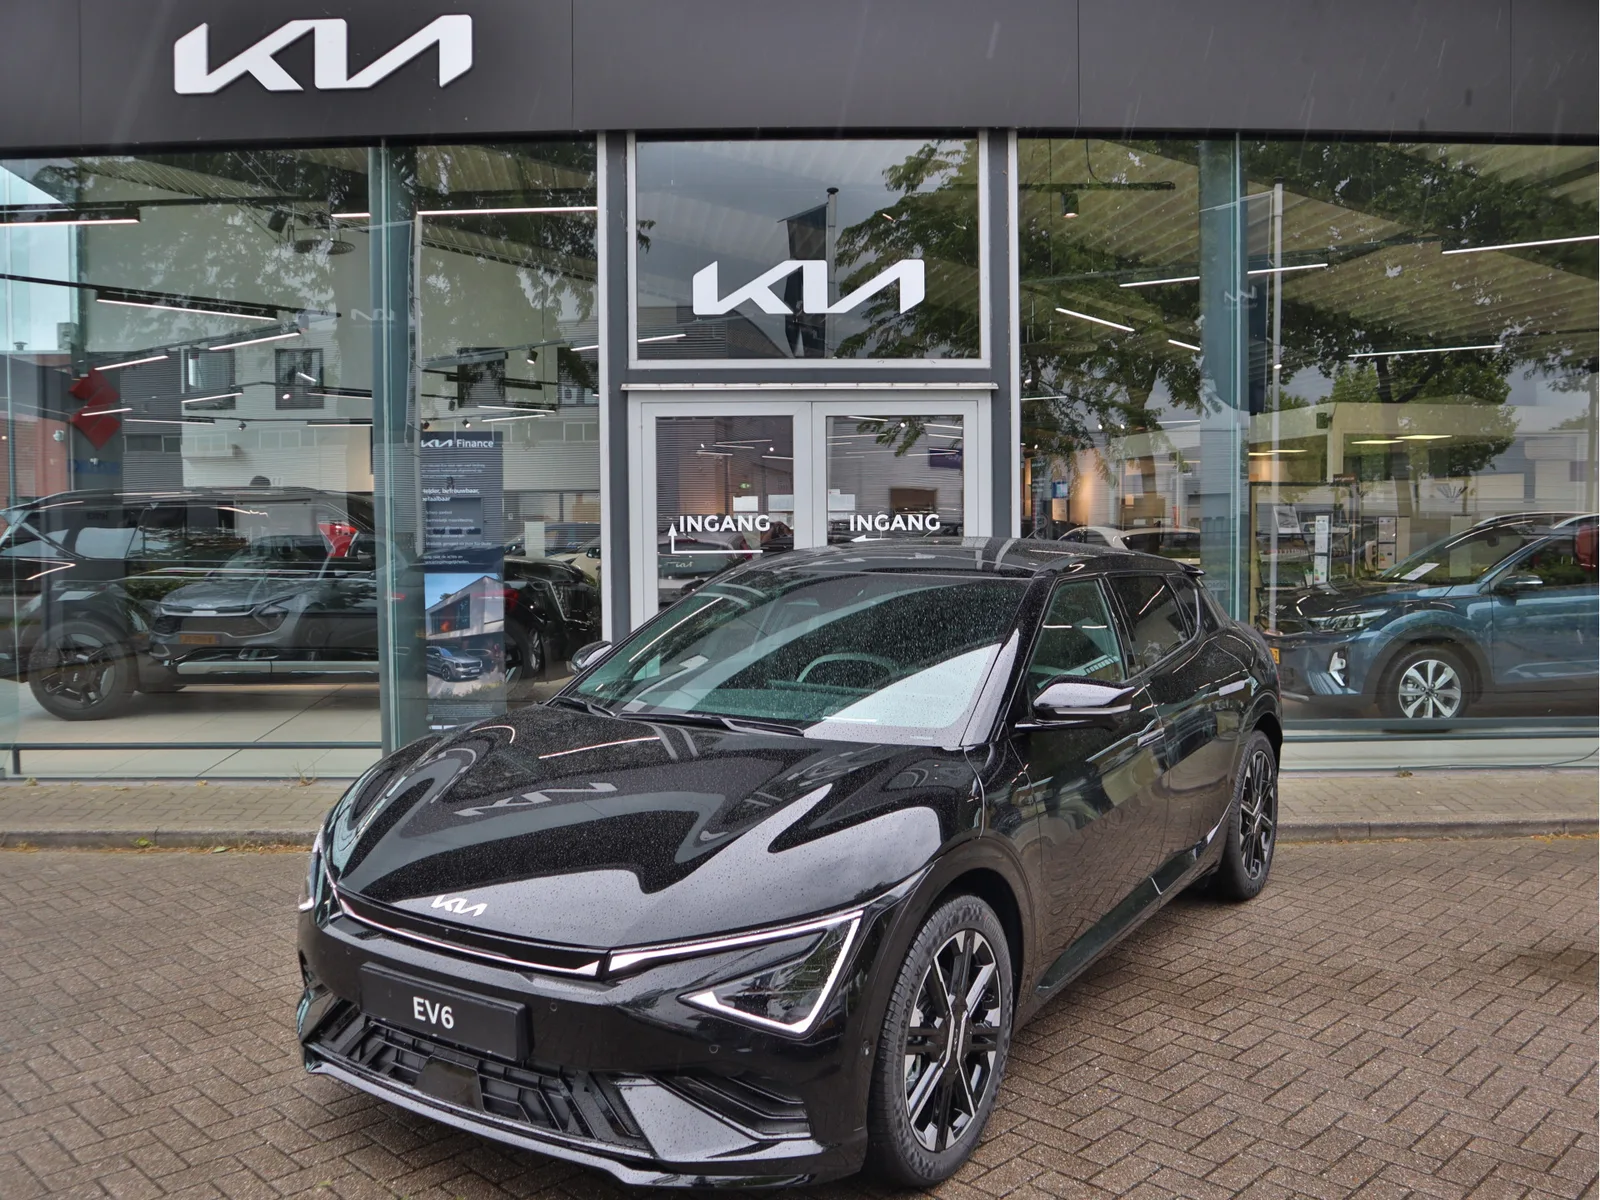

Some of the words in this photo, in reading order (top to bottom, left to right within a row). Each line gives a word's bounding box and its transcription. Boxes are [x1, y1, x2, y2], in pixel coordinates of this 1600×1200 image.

[174, 14, 473, 95] KIA
[692, 258, 925, 315] KIA
[456, 438, 494, 448] Finance
[679, 514, 771, 532] INGANG
[849, 513, 941, 532] INGANG
[430, 895, 488, 917] KIA
[413, 995, 456, 1030] EV6
